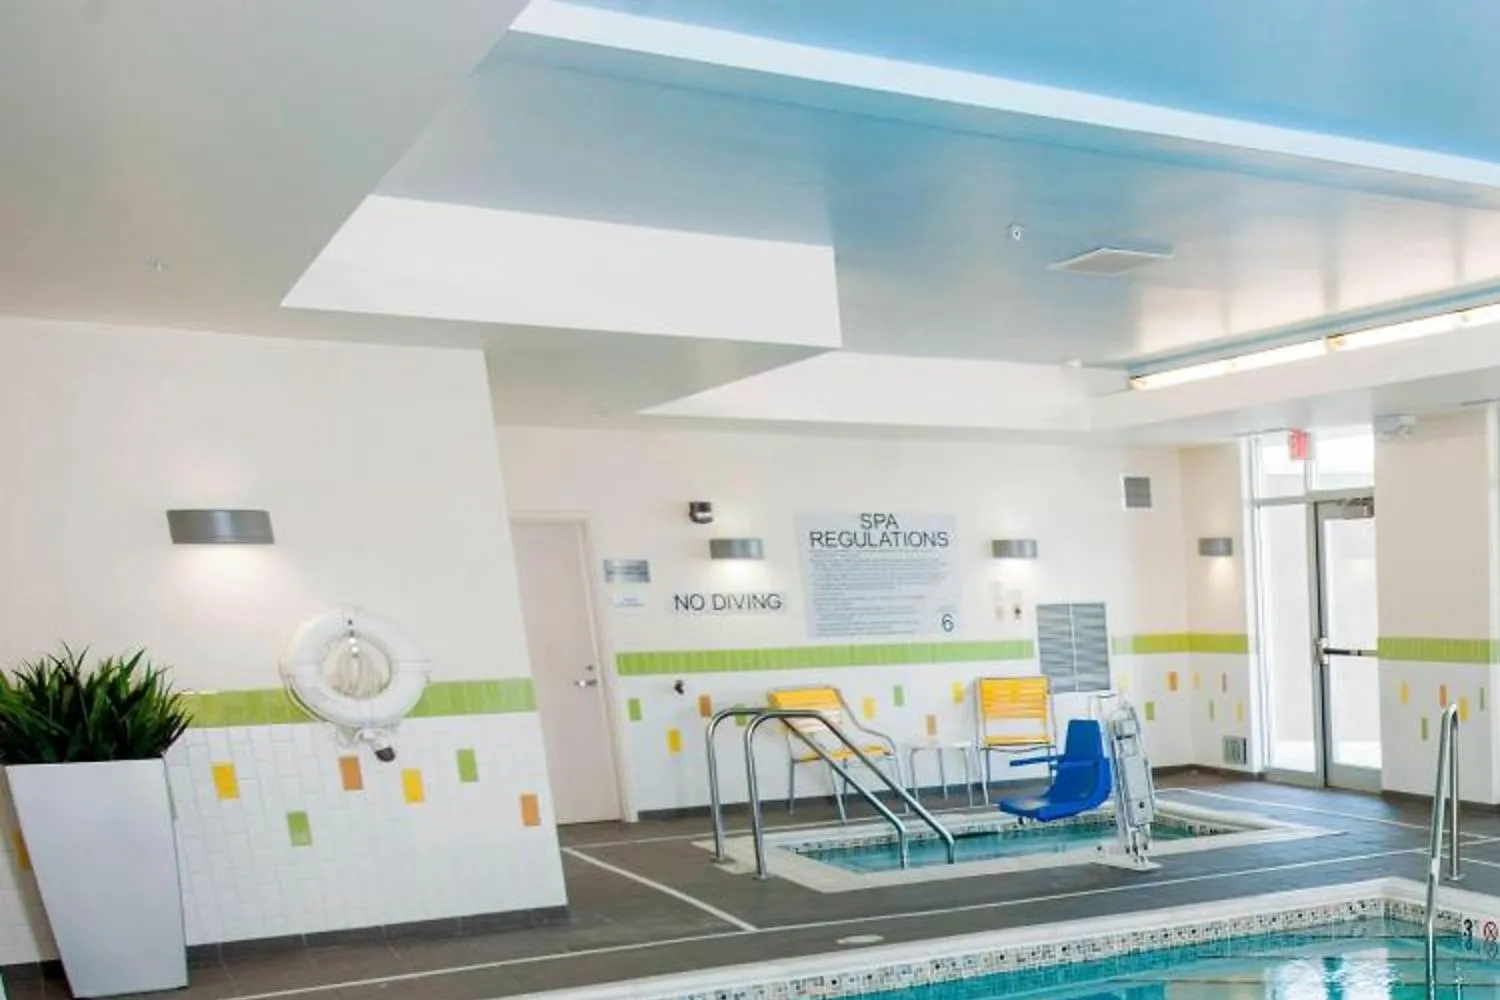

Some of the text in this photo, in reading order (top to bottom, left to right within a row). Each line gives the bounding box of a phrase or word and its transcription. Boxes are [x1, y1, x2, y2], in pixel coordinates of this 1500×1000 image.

[860, 513, 899, 530] SPA
[809, 531, 949, 549] REGULATIONS
[673, 592, 783, 611] NO DIVING
[941, 613, 955, 633] 6
